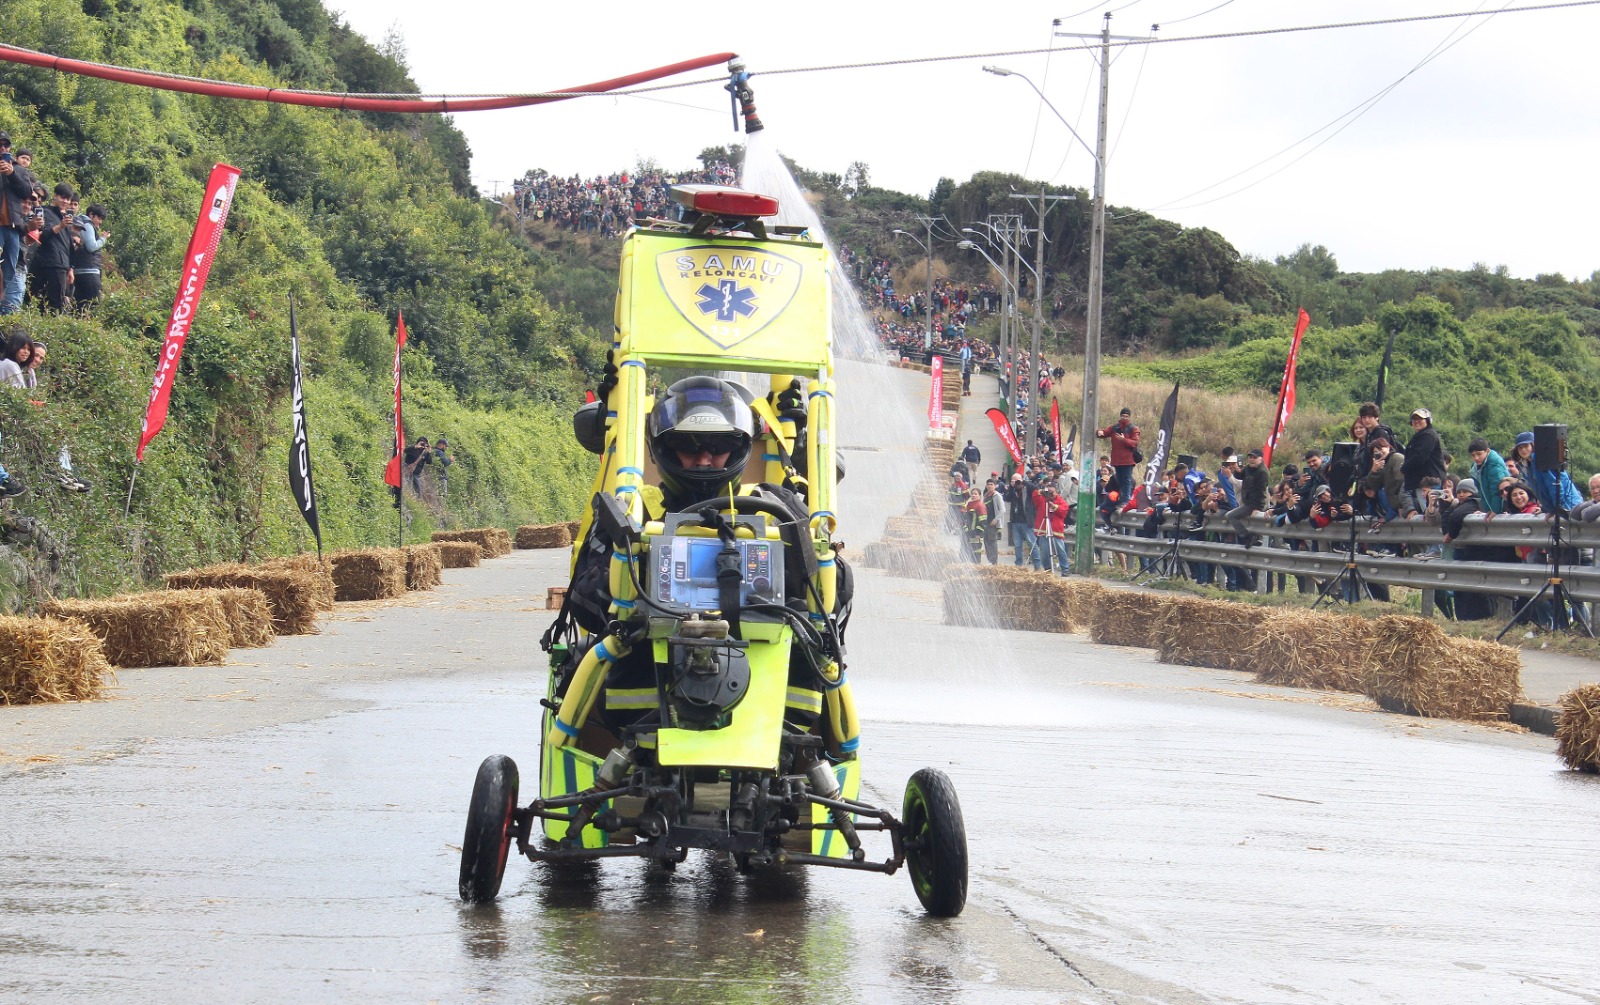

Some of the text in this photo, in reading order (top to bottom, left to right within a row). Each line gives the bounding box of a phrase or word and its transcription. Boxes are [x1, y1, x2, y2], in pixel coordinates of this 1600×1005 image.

[676, 254, 784, 277] SAMU
[680, 269, 775, 284] RELONCAVI
[711, 325, 741, 337] 131
